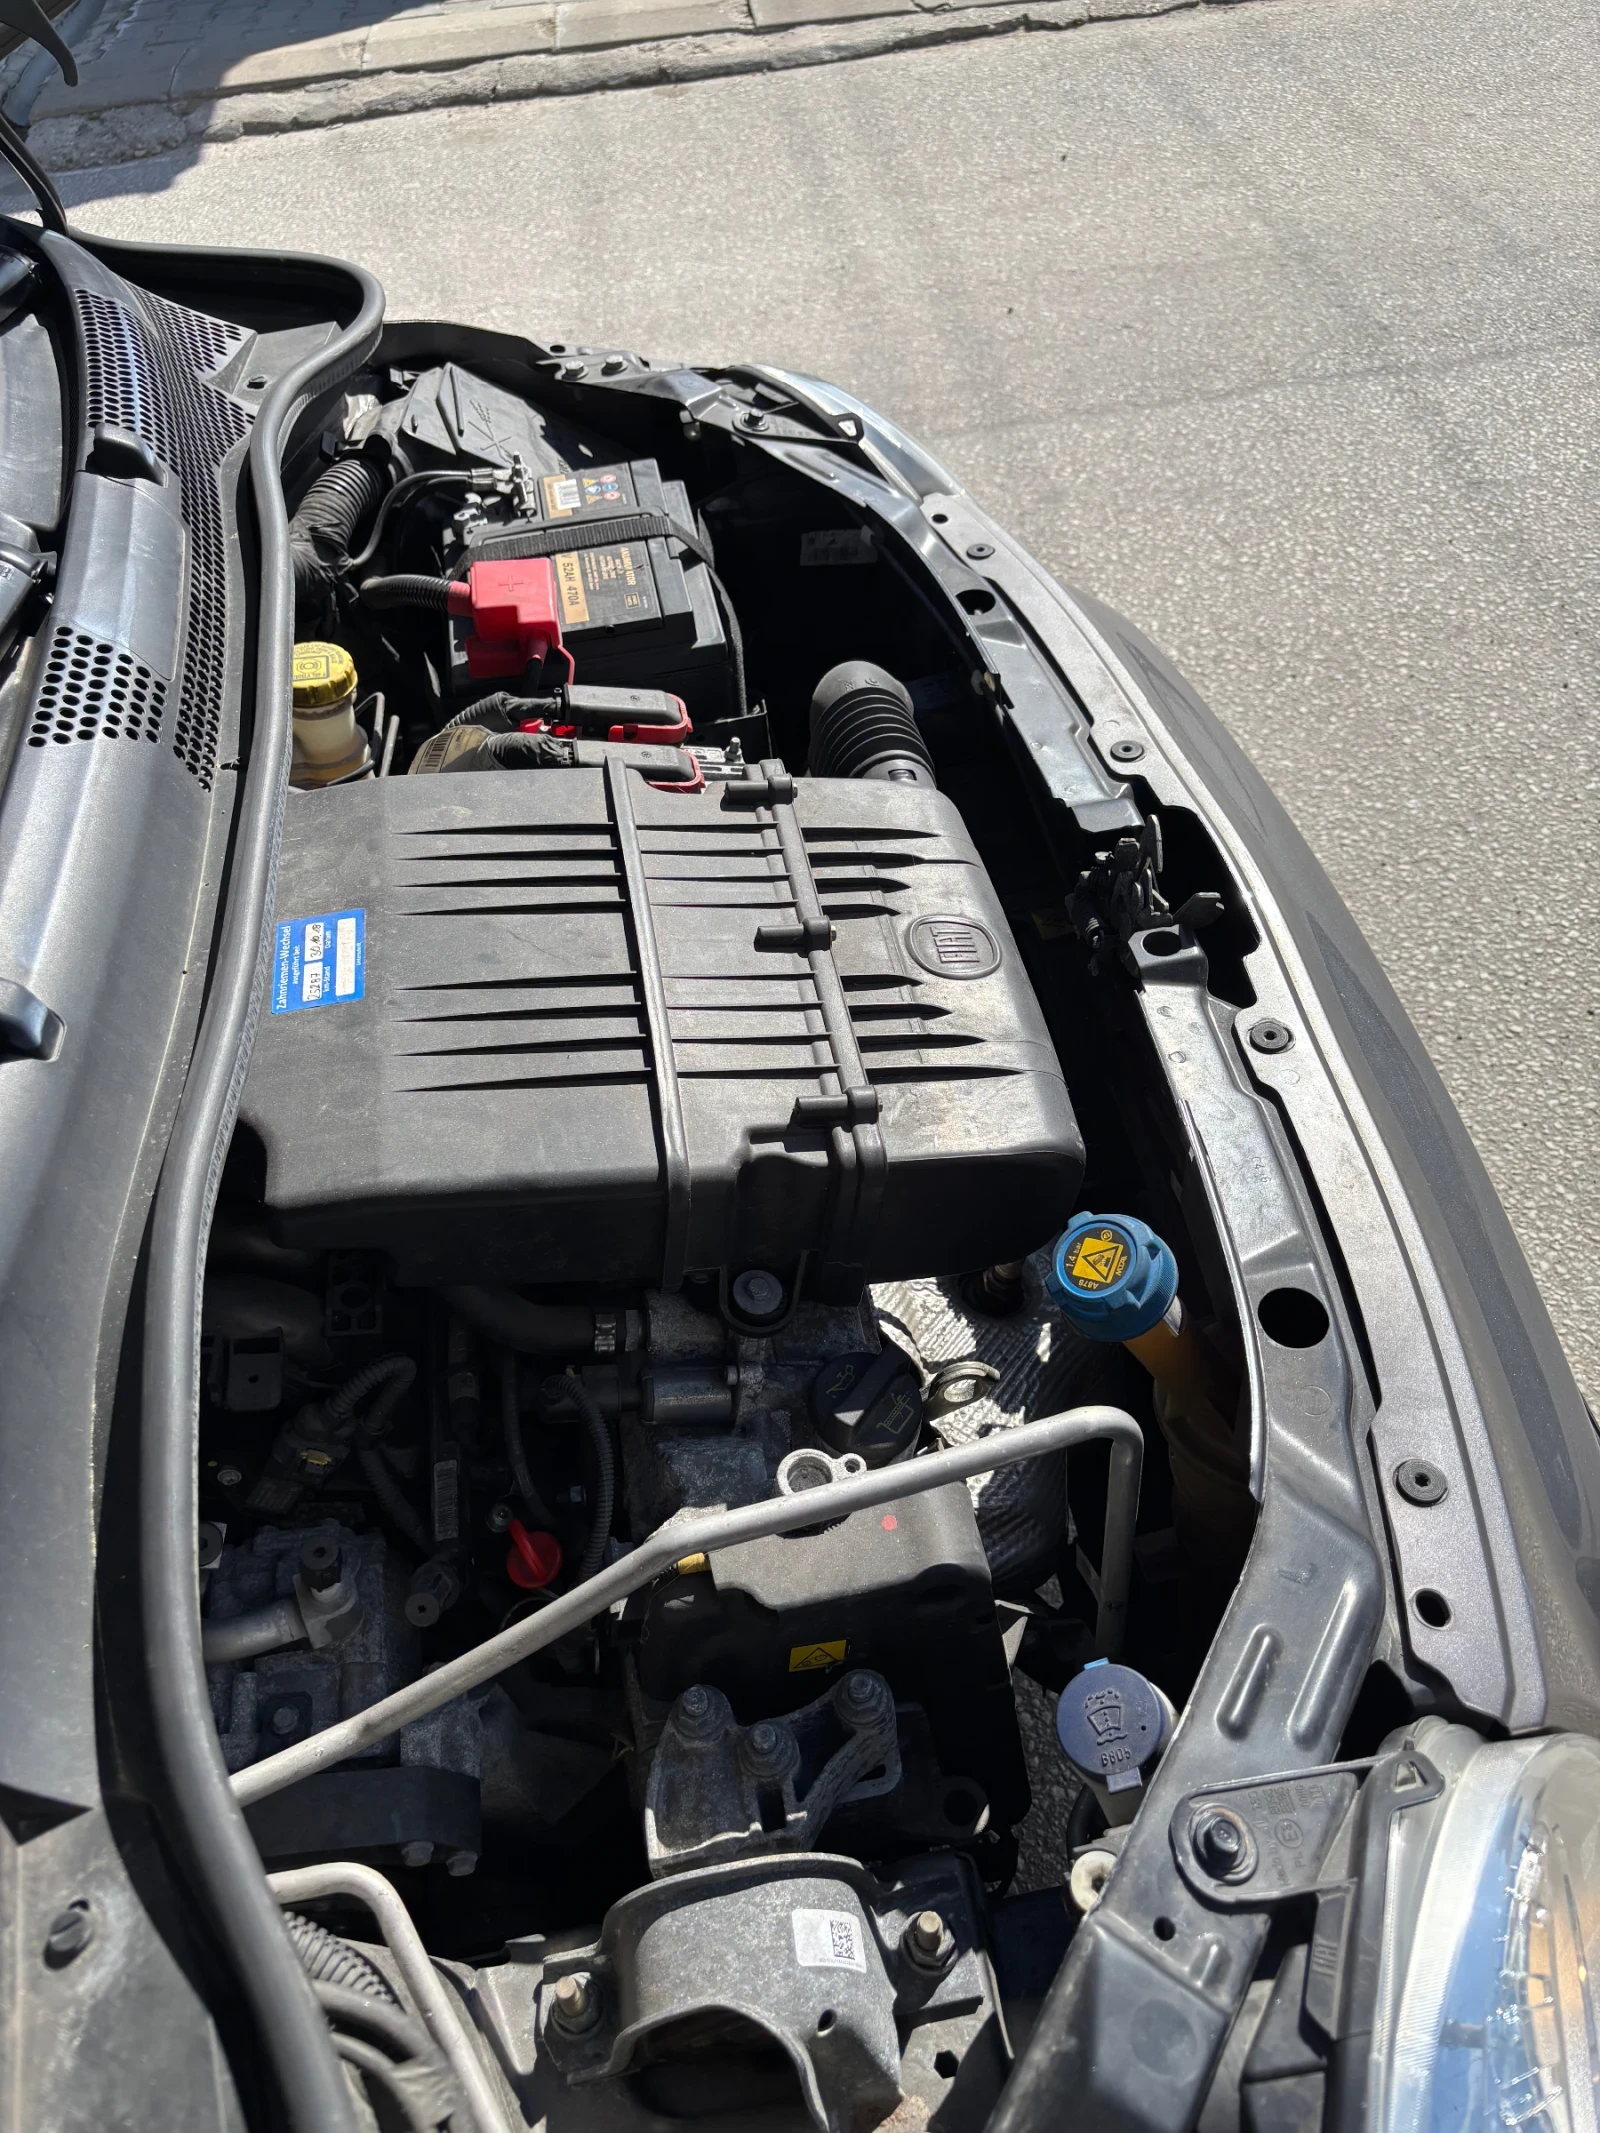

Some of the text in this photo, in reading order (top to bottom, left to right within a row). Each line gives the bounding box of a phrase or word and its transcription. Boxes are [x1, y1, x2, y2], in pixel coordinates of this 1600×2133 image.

[563, 562, 576, 582] 52AH
[567, 586, 580, 606] 470A
[929, 926, 980, 964] FIAT
[276, 925, 291, 1010] Zahnriemen-Wechsel
[1065, 1242, 1081, 1267] 1.4 bar
